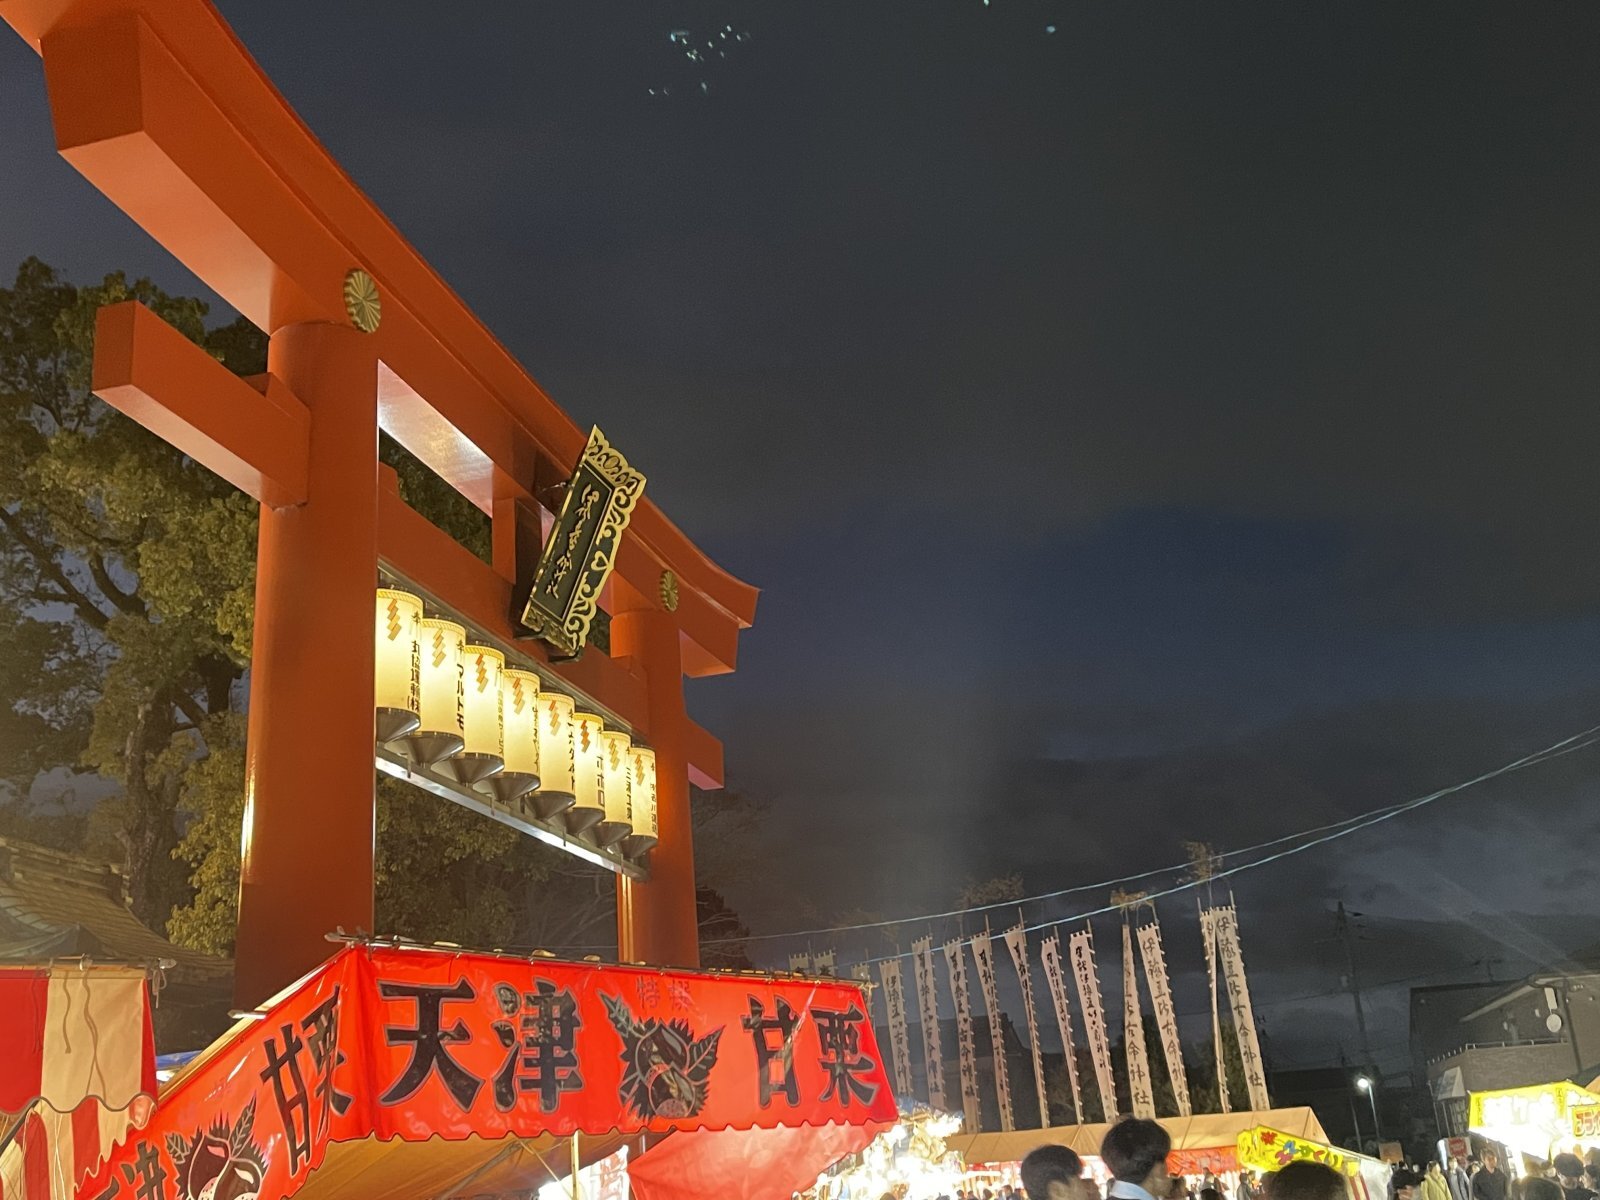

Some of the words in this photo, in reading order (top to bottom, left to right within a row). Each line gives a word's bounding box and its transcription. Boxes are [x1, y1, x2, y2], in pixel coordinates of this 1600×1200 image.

[259, 984, 355, 1177] 甘栗
[377, 977, 584, 1115] 天津
[741, 992, 883, 1110] 甘栗
